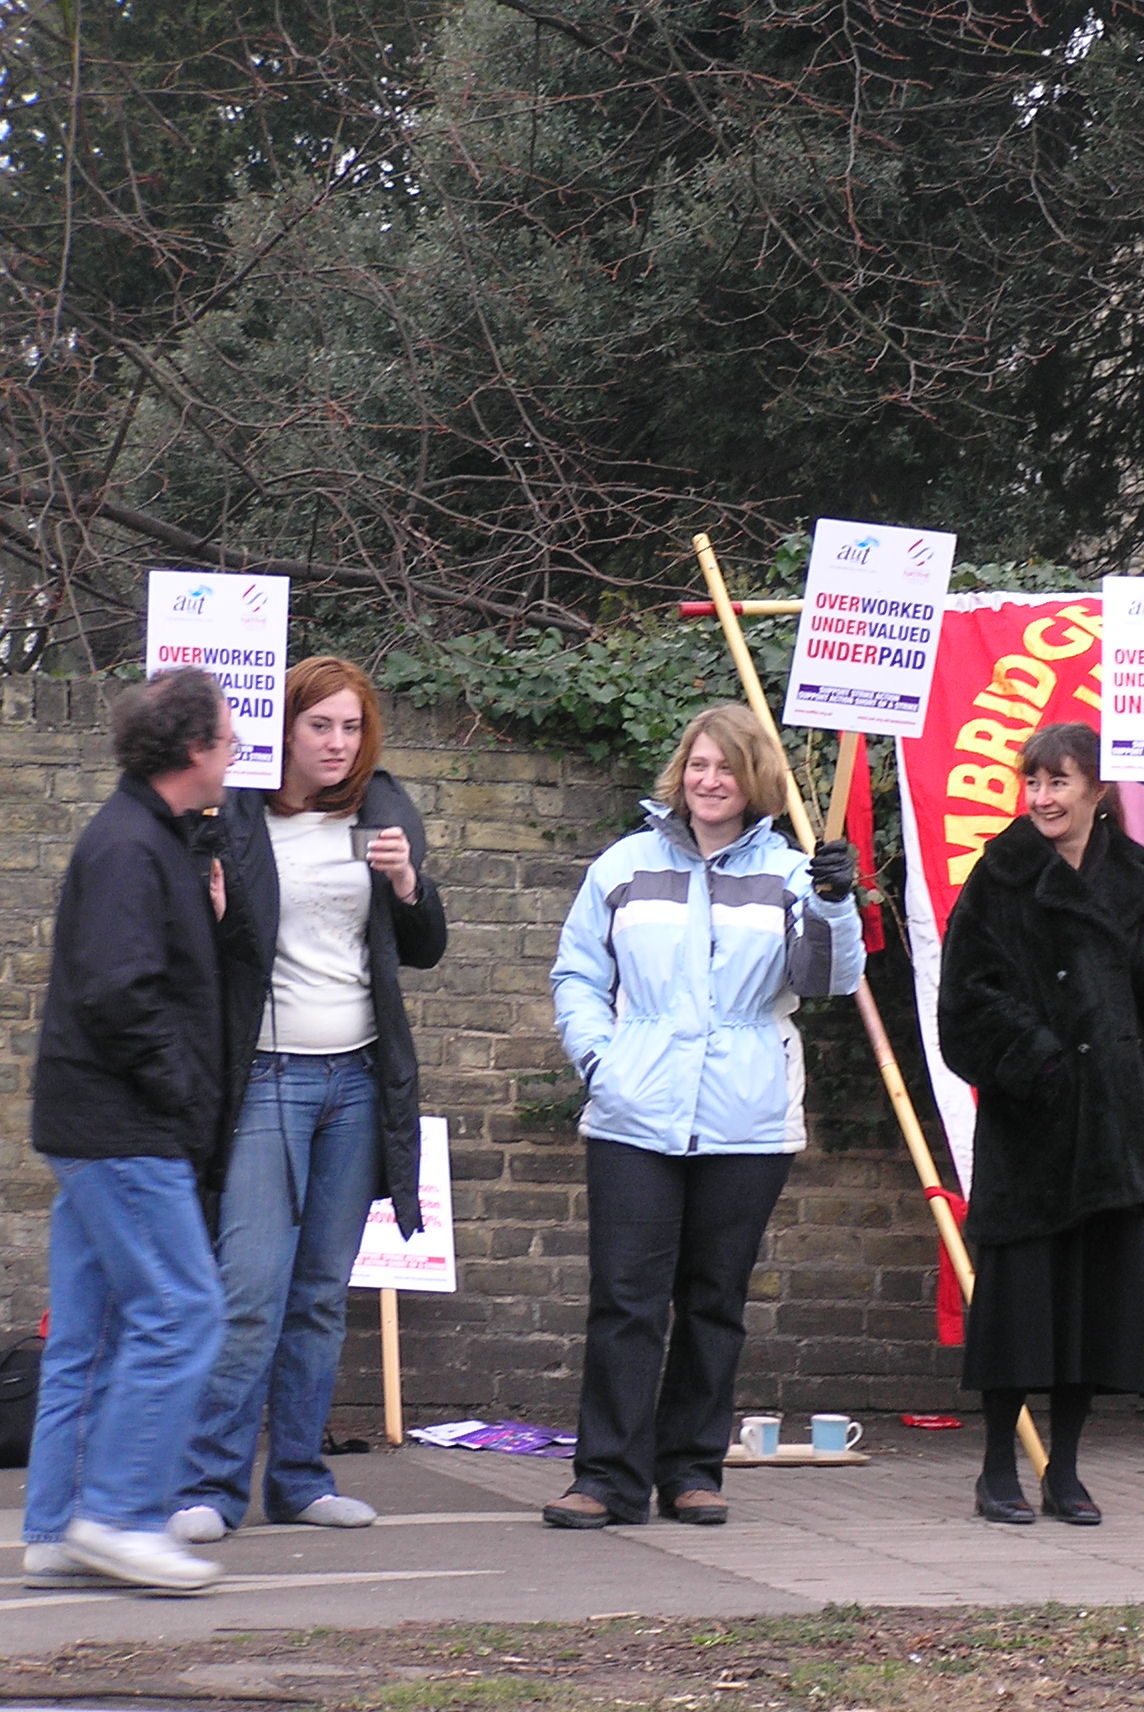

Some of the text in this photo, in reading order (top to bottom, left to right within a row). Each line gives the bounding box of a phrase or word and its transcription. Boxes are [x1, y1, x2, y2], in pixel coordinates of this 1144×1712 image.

[816, 592, 934, 621] OVERWORKED
[811, 615, 931, 643] UNDERVALUED
[159, 645, 275, 667] OVERWORKED
[806, 638, 926, 670] UNDERPAID
